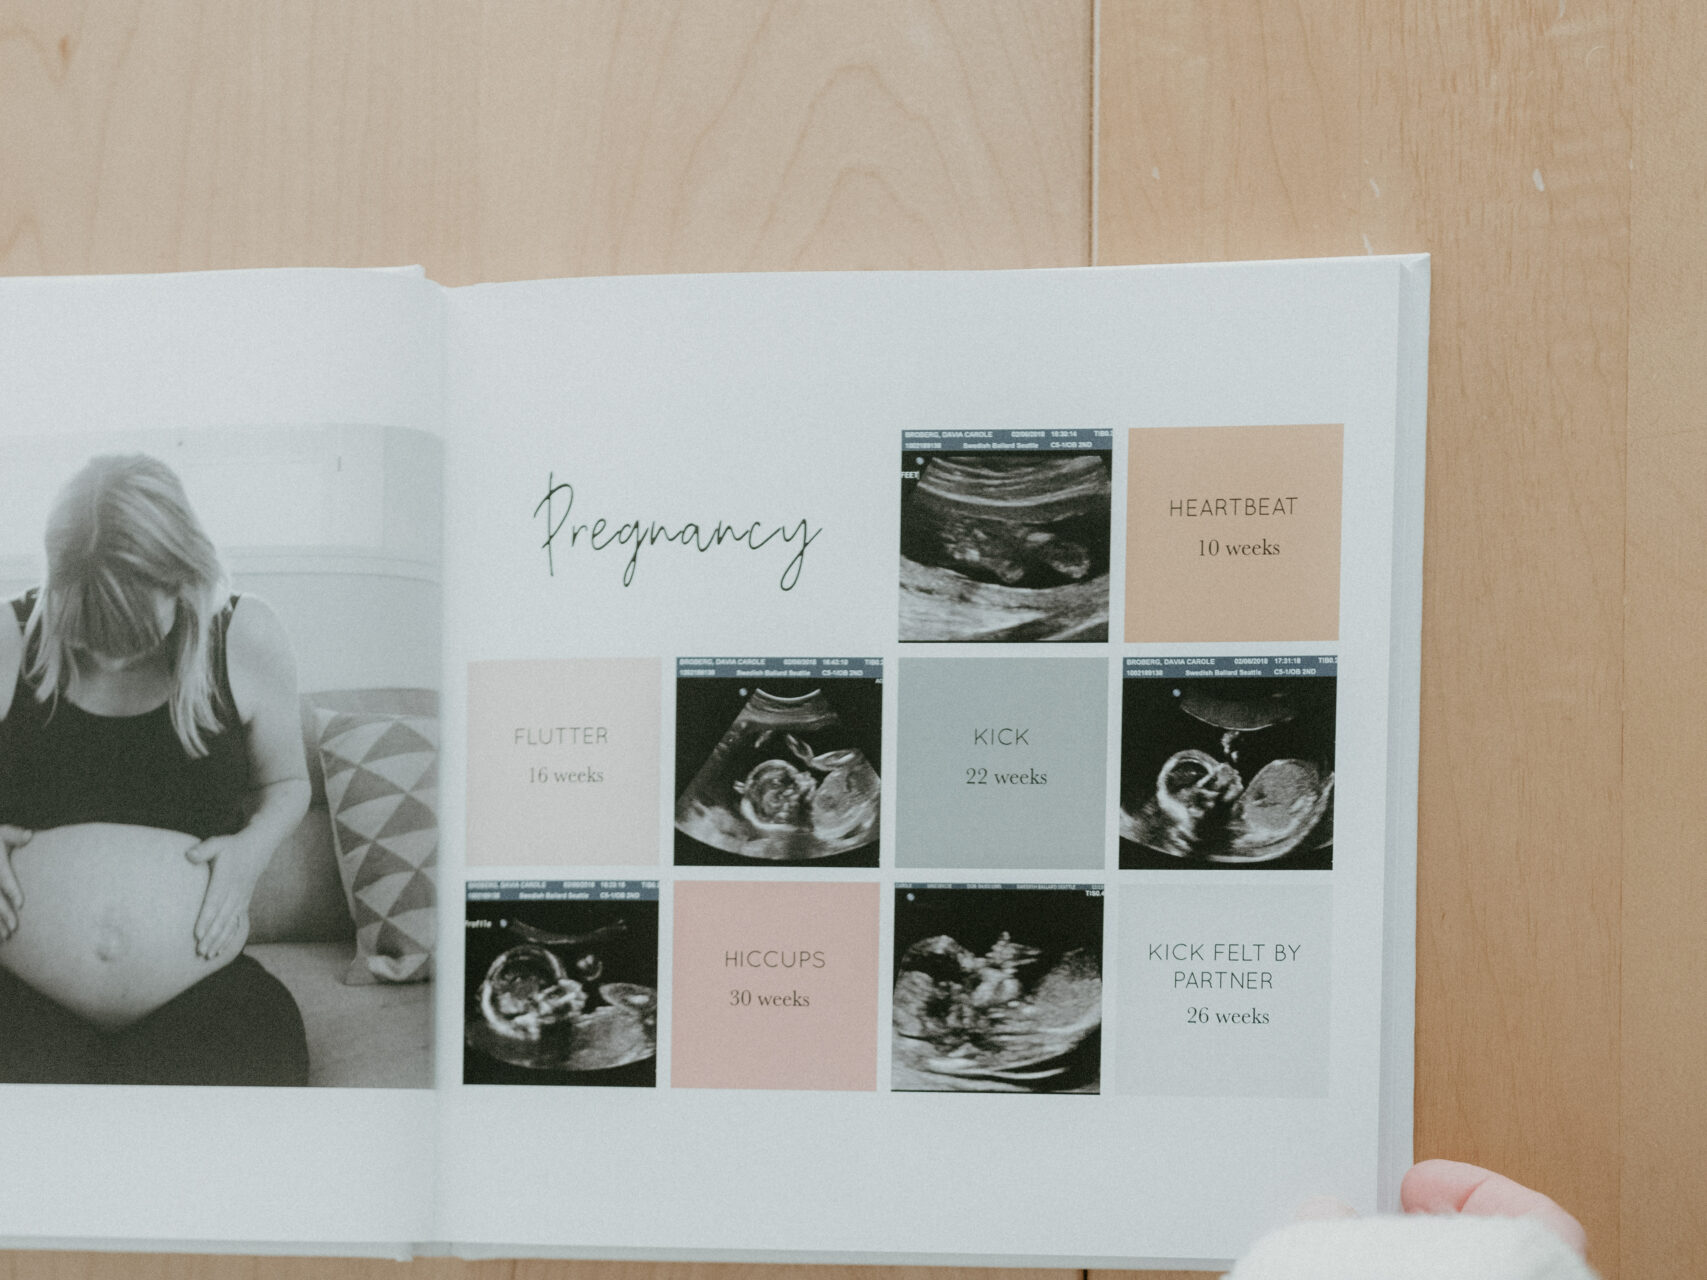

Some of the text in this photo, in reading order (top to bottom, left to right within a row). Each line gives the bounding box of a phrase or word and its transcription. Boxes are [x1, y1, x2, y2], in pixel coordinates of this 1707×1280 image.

[1169, 496, 1298, 519] HEARTBEAT
[533, 471, 823, 592] Pregnancy
[1198, 537, 1281, 557] 10 weeks
[1126, 658, 1163, 666] BROBERG,
[1164, 658, 1186, 666] DAVIA
[1186, 658, 1216, 666] CAROLE
[1184, 669, 1214, 677] Swedish
[1239, 668, 1263, 676] Seattle
[514, 726, 609, 746] FLUTTER
[973, 727, 1029, 747] KICK
[529, 766, 605, 784] 16 weeks
[965, 766, 1048, 785] 22 weeks
[724, 949, 827, 970] HICCUPS
[1148, 942, 1303, 963] KICK FELT BY
[1173, 970, 1273, 991] PARTNER
[730, 988, 811, 1008] 30 weeks
[1187, 1006, 1270, 1025] 26 weeks
